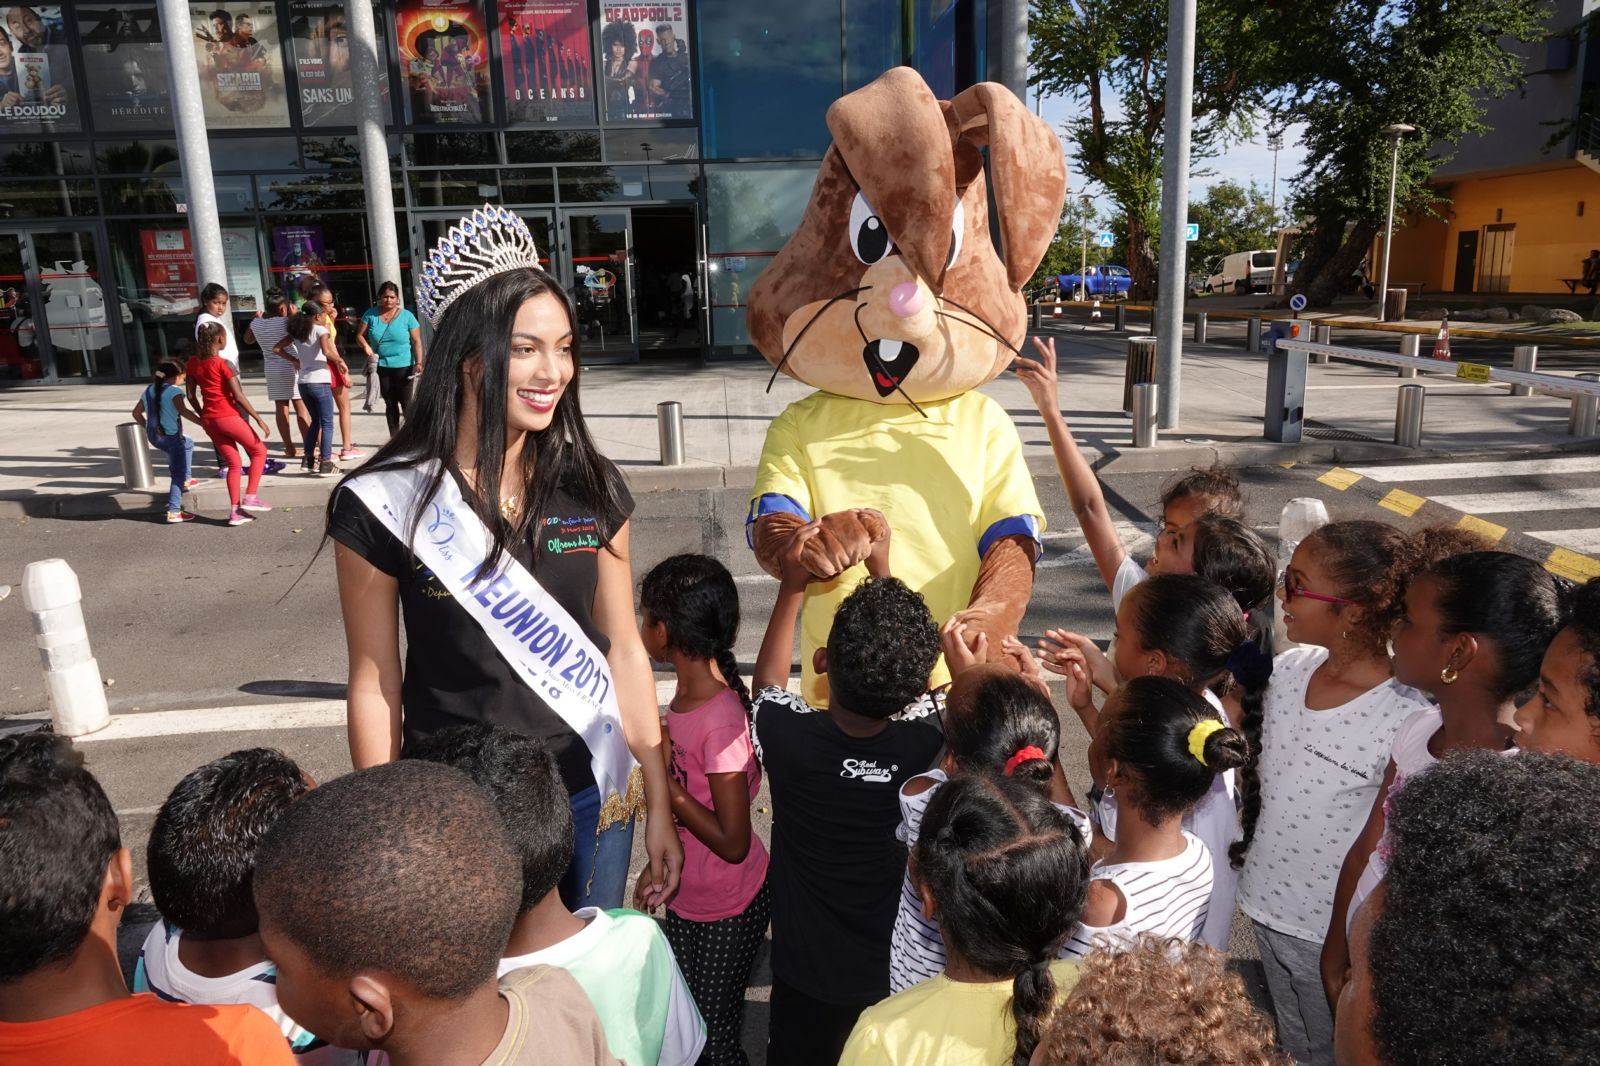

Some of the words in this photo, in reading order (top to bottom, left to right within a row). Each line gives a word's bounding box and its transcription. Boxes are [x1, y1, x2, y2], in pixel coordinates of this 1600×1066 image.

[604, 7, 672, 22] DEADPOOL
[673, 7, 682, 21] 2
[216, 72, 261, 87] SICARIO
[302, 88, 334, 103] SANS
[335, 87, 353, 102] UN
[13, 105, 66, 116] DOUDOU
[559, 648, 609, 705] 2017
